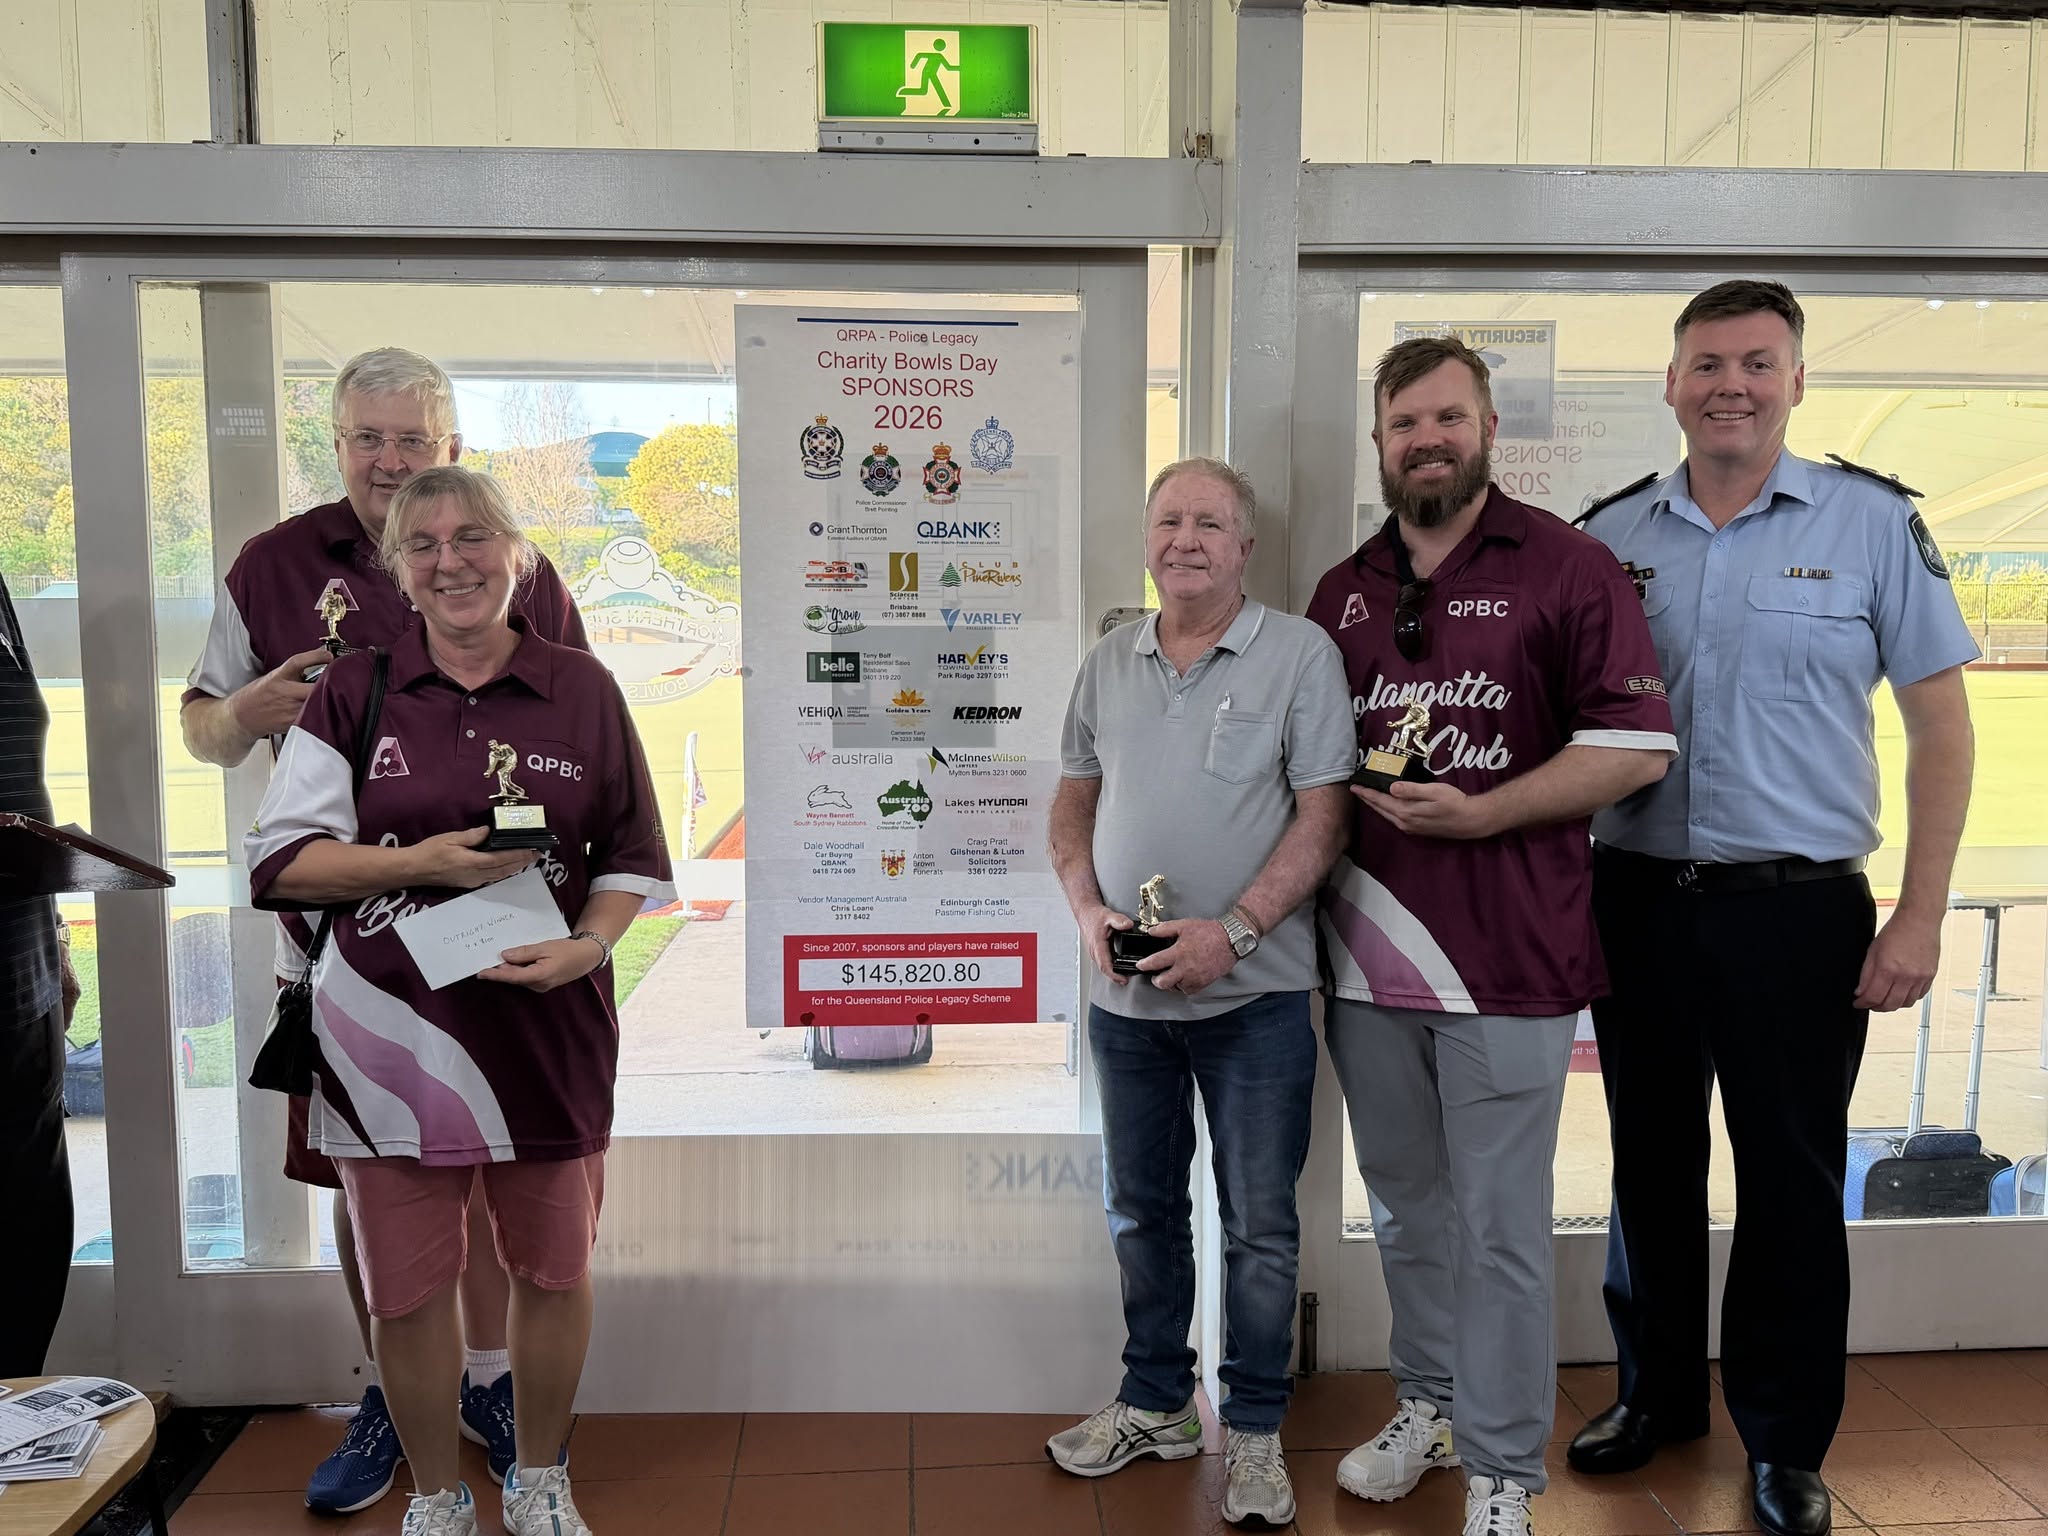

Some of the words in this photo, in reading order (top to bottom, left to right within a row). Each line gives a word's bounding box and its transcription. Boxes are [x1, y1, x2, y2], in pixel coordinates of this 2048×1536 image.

[836, 329, 876, 343] QRPA
[889, 330, 928, 344] Police
[932, 331, 978, 347] Legacy
[817, 350, 888, 374] Charity
[894, 352, 952, 372] Bowls
[960, 353, 998, 376] Day
[842, 377, 974, 398] SPONSORS
[874, 404, 943, 430] 2026
[826, 525, 850, 534] Grant
[850, 525, 888, 534] Thornton
[917, 521, 992, 539] QBANK
[1447, 600, 1509, 618] QPBC
[828, 608, 861, 632] grove
[963, 612, 1022, 624] VARLEY
[820, 658, 855, 672] belle
[954, 672, 974, 680] Ridge
[953, 706, 1022, 720] KEDRON
[808, 746, 826, 764] Virgin
[832, 753, 893, 765] australia
[1422, 724, 1513, 776] Club
[526, 753, 584, 782] QPBC
[880, 796, 930, 804] Australia
[945, 799, 976, 807] Lakes
[978, 798, 1028, 806] HYUNDAI
[806, 812, 827, 820] Wayne
[804, 842, 824, 850] Dale
[825, 842, 864, 850] Woodhall
[966, 838, 988, 847] Craig
[990, 838, 1008, 846] Pratt
[950, 848, 991, 856] Gilshenan
[992, 848, 999, 856] &
[1001, 848, 1024, 856] Luton
[912, 860, 936, 868] Brown
[968, 858, 1006, 866] Solicitors
[912, 868, 944, 876] Funerals
[798, 896, 824, 904] Vendor
[826, 896, 874, 905] Management
[940, 899, 982, 908] Edinburgh
[984, 898, 1010, 906] Castle
[935, 908, 966, 916] Pastime
[968, 908, 996, 918] Fishing
[998, 908, 1016, 916] Club
[803, 943, 830, 952] Since
[832, 943, 860, 953] 2007,
[862, 944, 906, 954] sponsors
[908, 942, 926, 951] and
[928, 942, 962, 954] players
[965, 942, 988, 950] have
[990, 941, 1020, 950] raised
[842, 962, 980, 986] $145,820.80
[812, 996, 825, 1006] for
[826, 996, 842, 1006] the
[844, 996, 902, 1006] Queensland
[904, 995, 934, 1004] Police
[936, 995, 970, 1006] Legacy
[972, 994, 1011, 1004] Scheme
